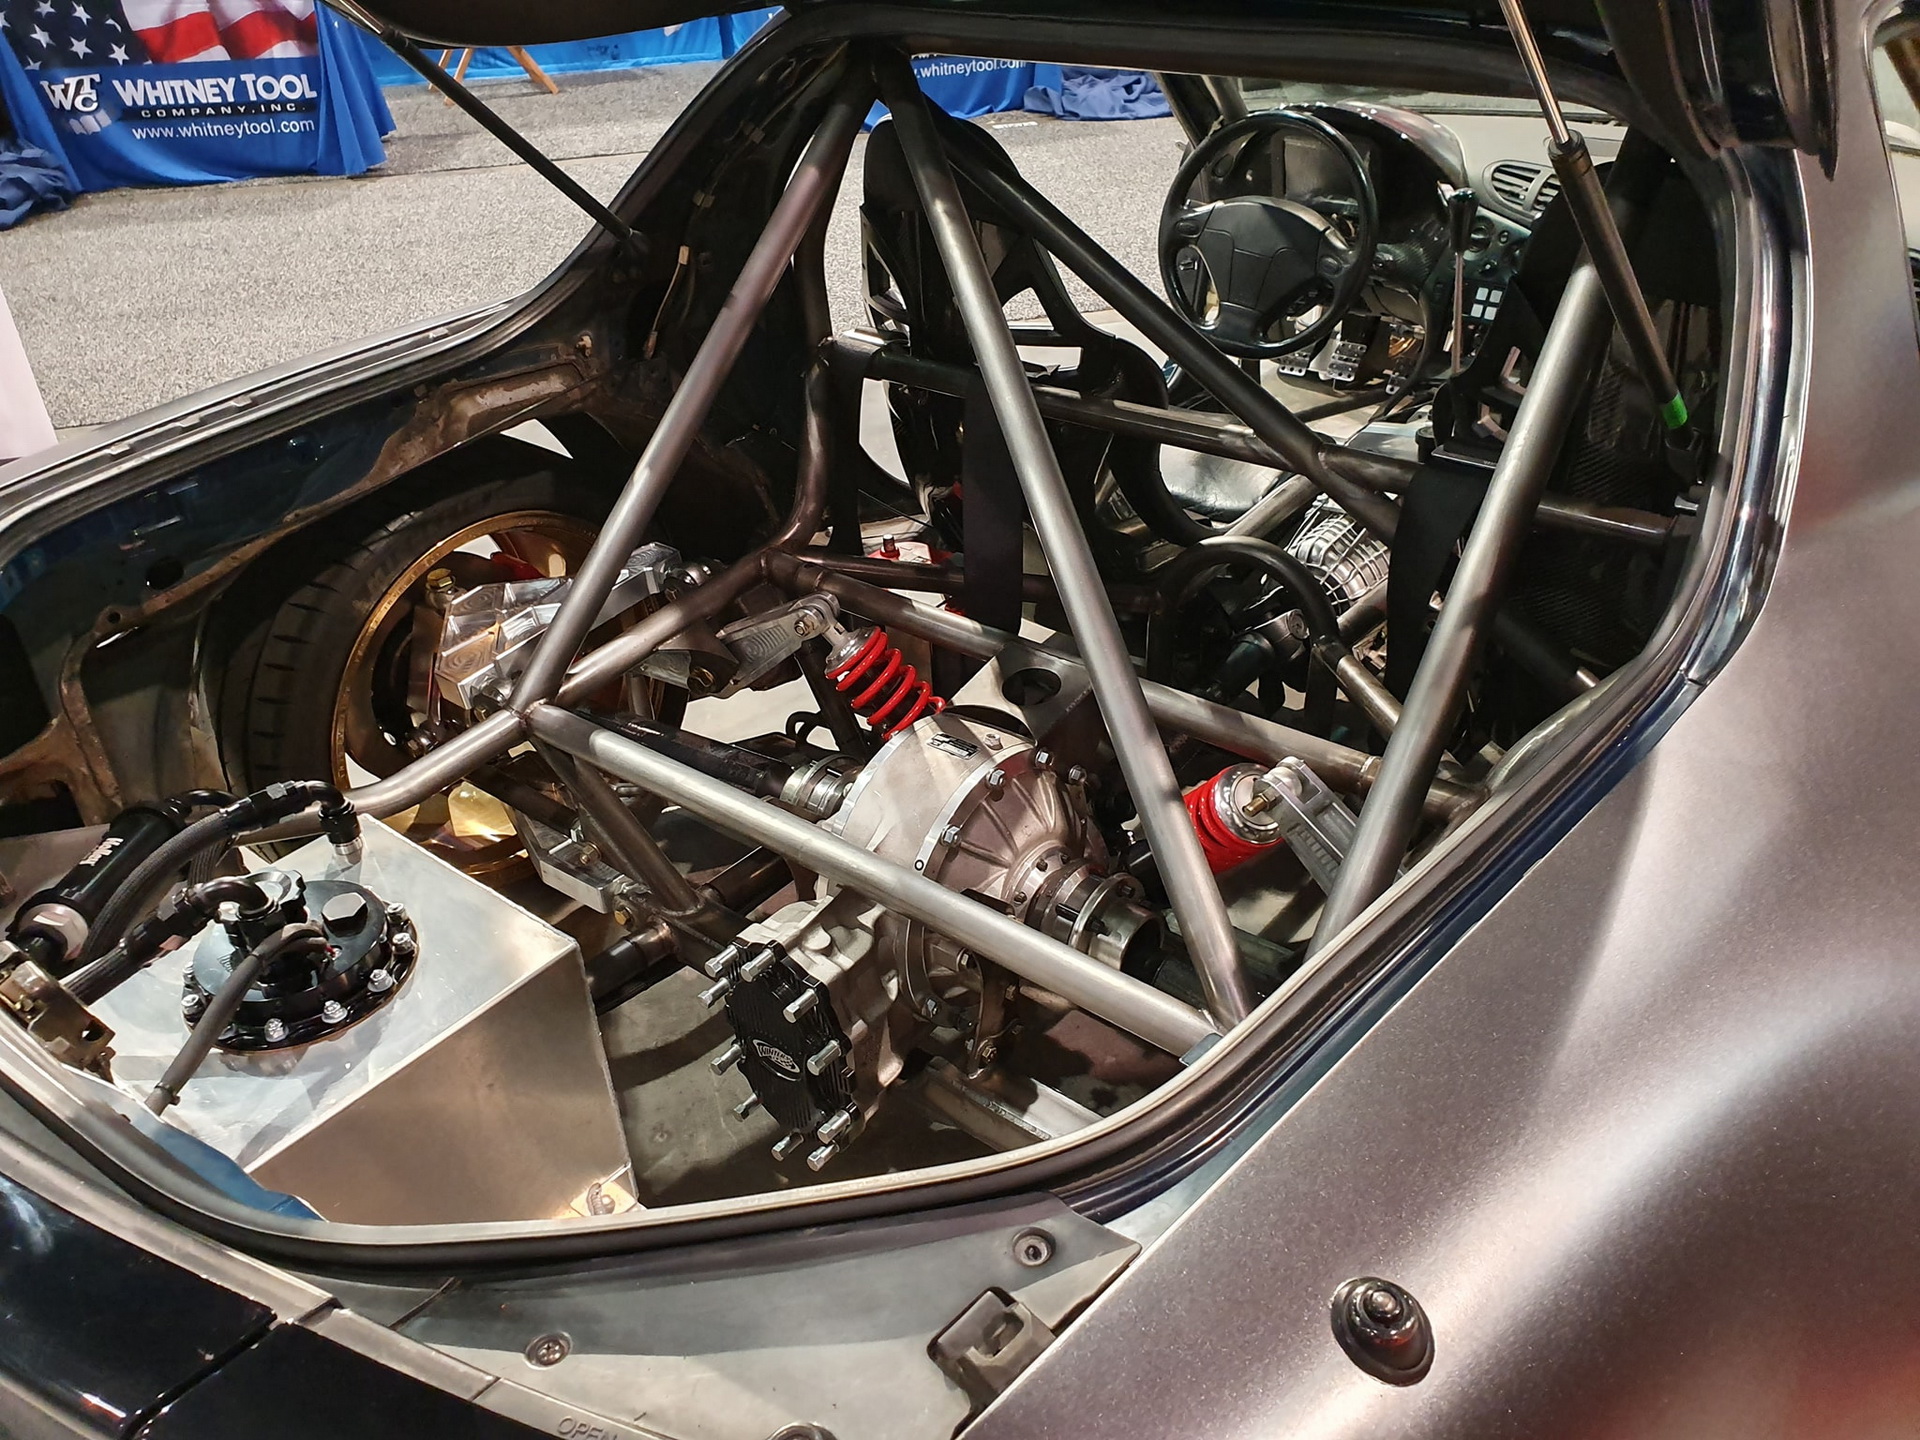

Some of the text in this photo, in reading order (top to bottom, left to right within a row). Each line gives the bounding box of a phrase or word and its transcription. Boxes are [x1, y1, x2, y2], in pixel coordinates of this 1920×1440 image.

[913, 59, 1026, 78] .whitneytool.com
[112, 73, 318, 107] WHITNEY TOOL
[132, 118, 315, 139] www.whitneytool.com
